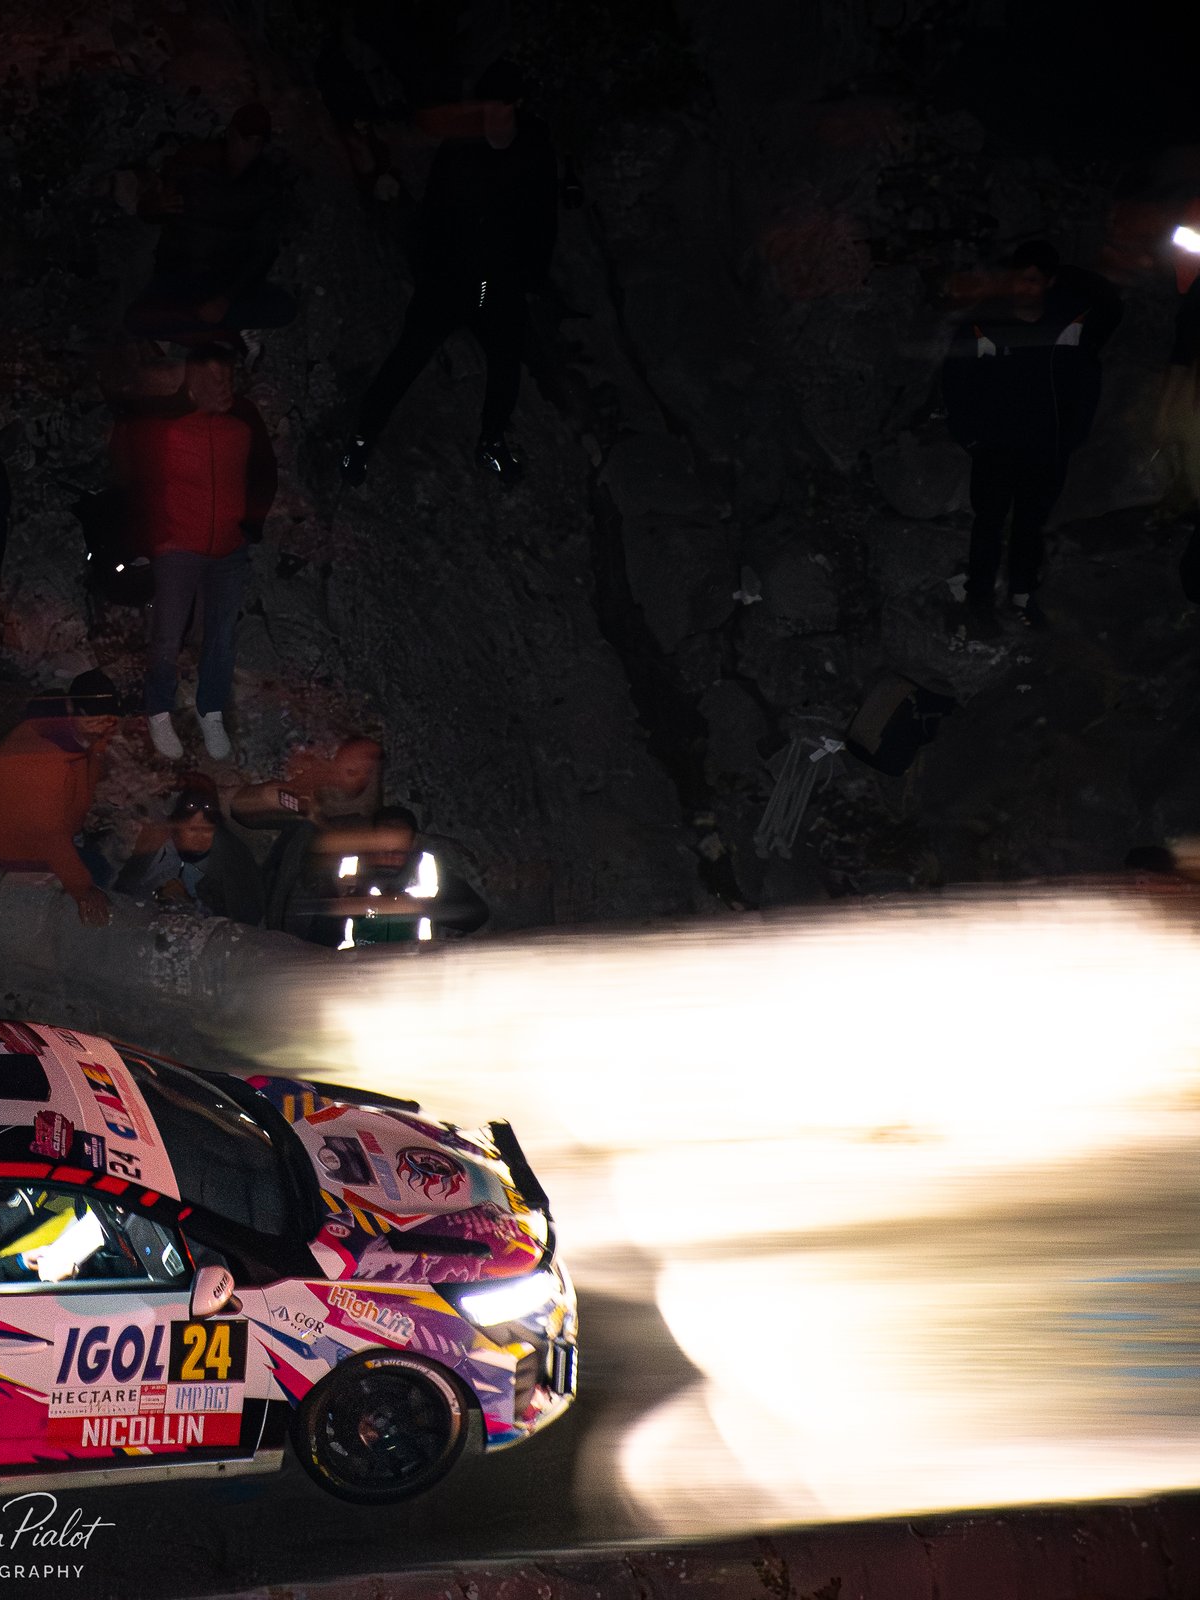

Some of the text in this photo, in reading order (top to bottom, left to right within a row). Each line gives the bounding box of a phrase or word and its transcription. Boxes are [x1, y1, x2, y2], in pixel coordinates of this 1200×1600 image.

[109, 1148, 141, 1180] 24
[294, 1312, 324, 1334] GGR
[56, 1324, 165, 1384] IGOL
[181, 1324, 231, 1381] 24
[51, 1389, 137, 1405] HECTARE
[176, 1386, 231, 1410] IMPACT
[82, 1415, 205, 1447] NICOLLIN
